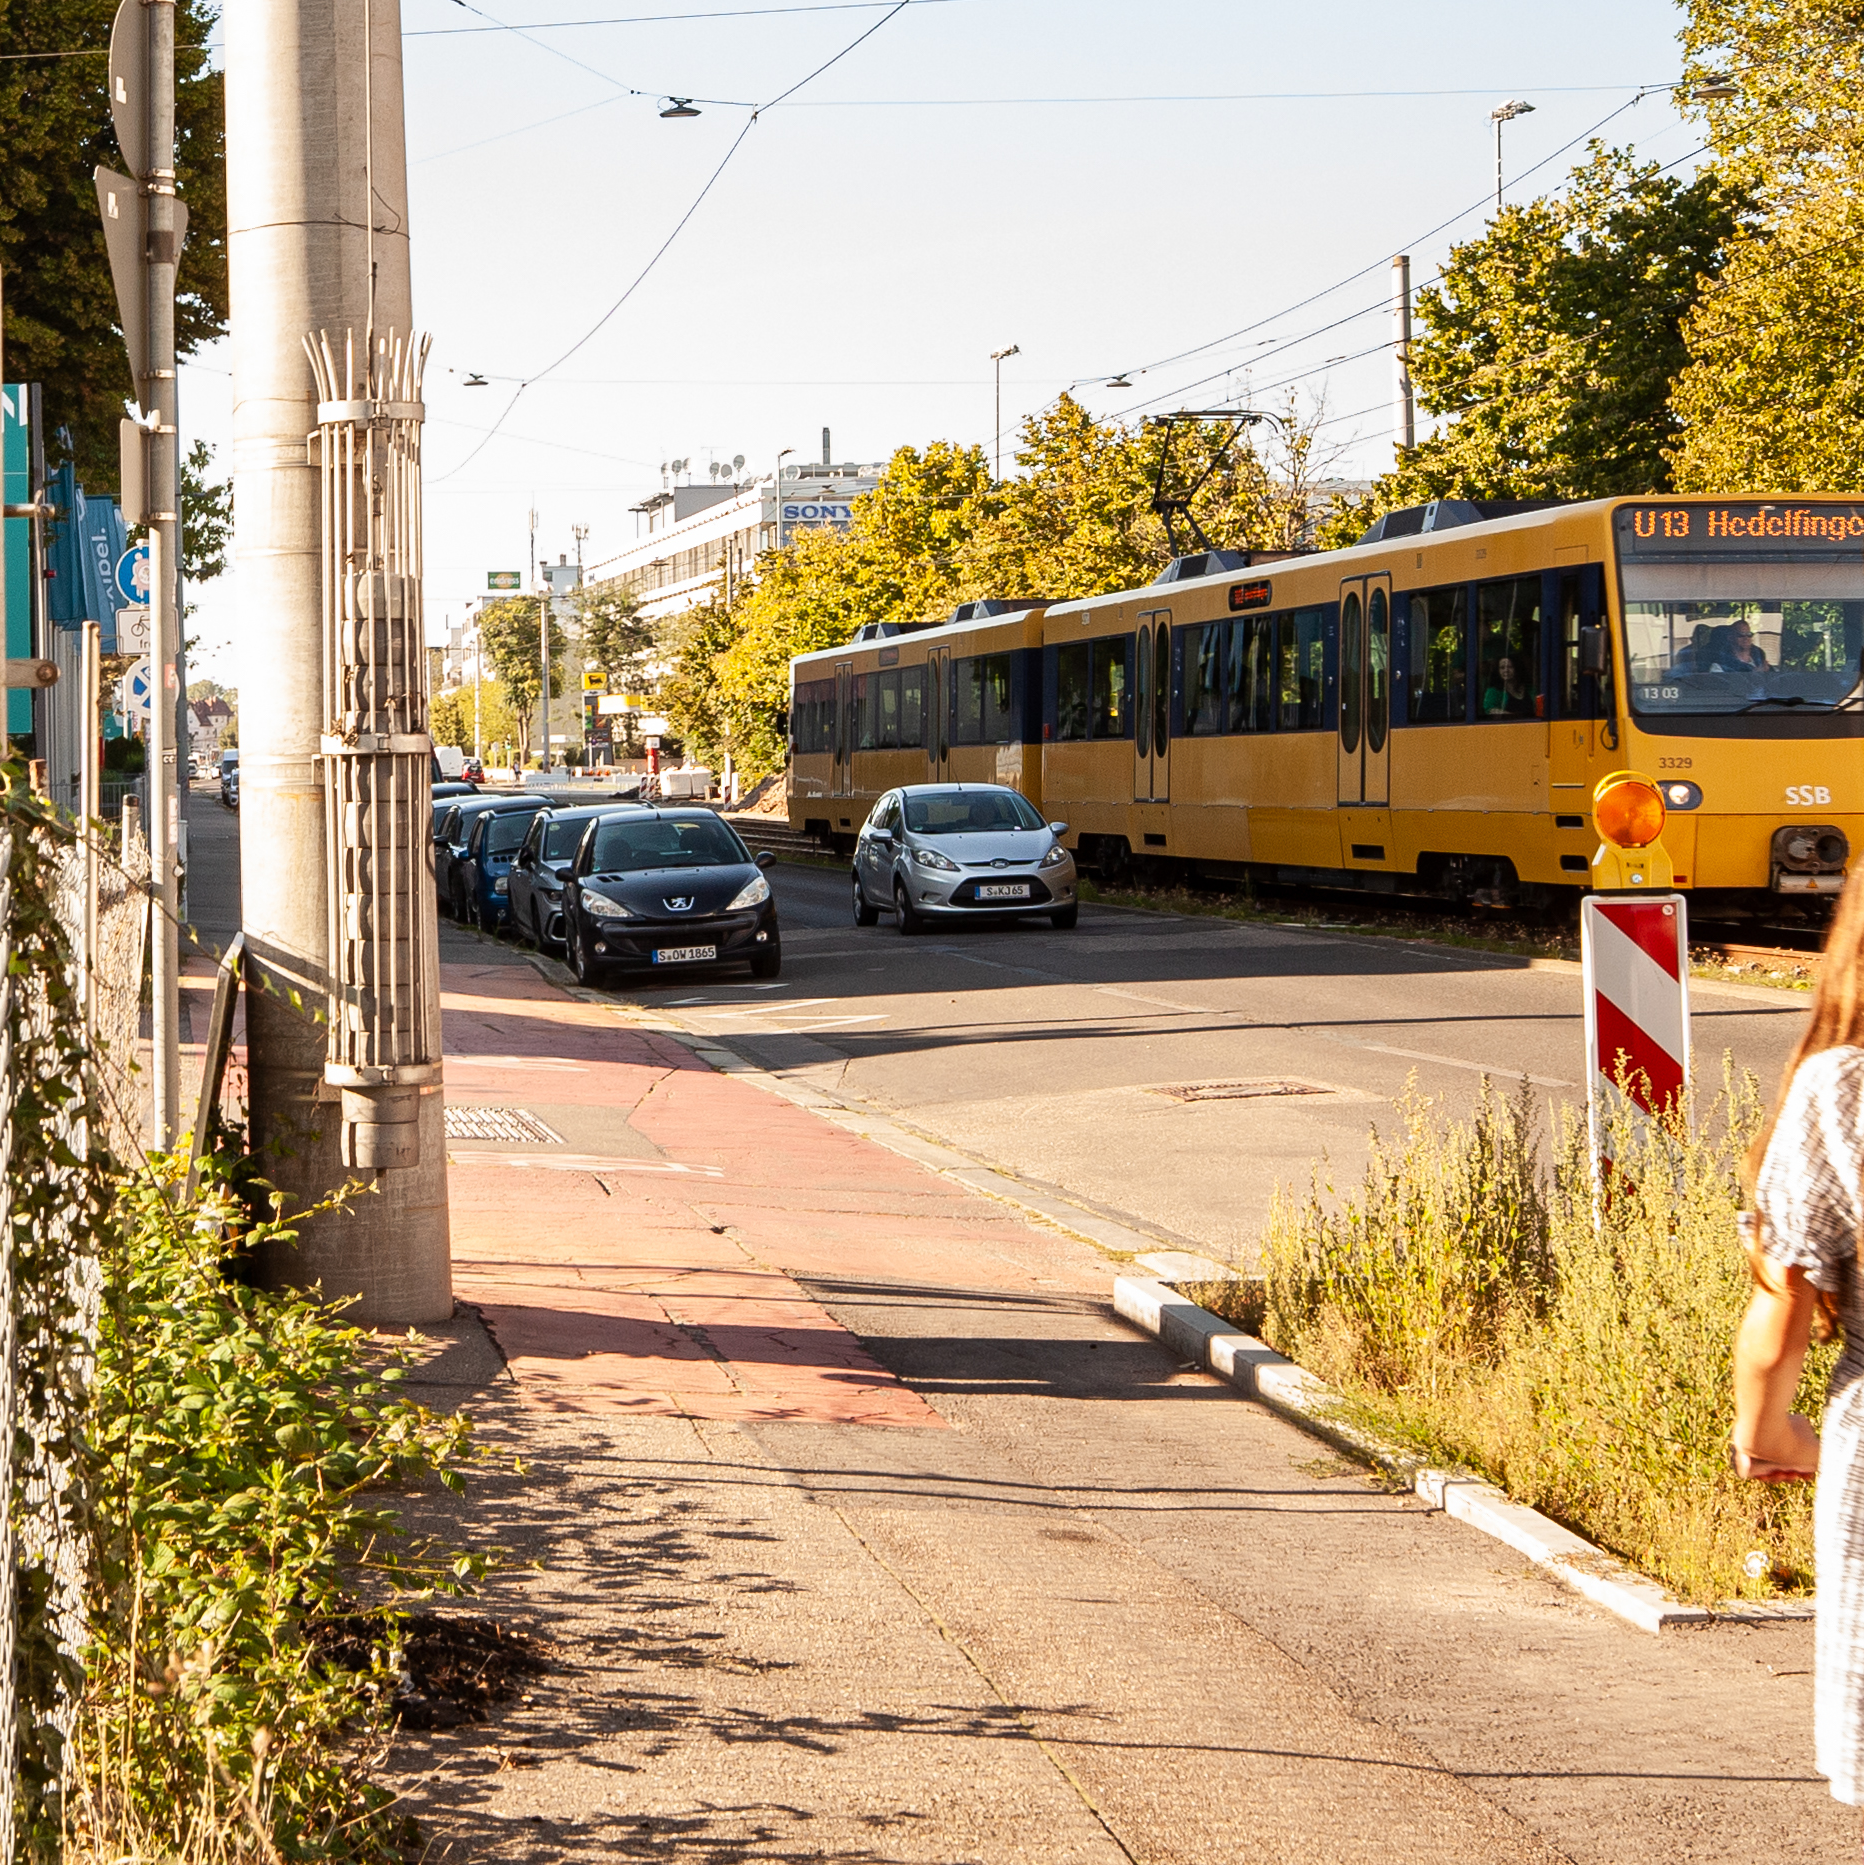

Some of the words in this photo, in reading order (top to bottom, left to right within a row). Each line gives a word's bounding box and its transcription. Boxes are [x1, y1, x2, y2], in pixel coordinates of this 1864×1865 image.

[783, 505, 853, 519] SONY
[1634, 510, 1690, 538] U13
[1643, 687, 1659, 699] 13
[1662, 687, 1679, 699] 03
[1659, 757, 1693, 769] 3329
[1785, 785, 1831, 806] SSB
